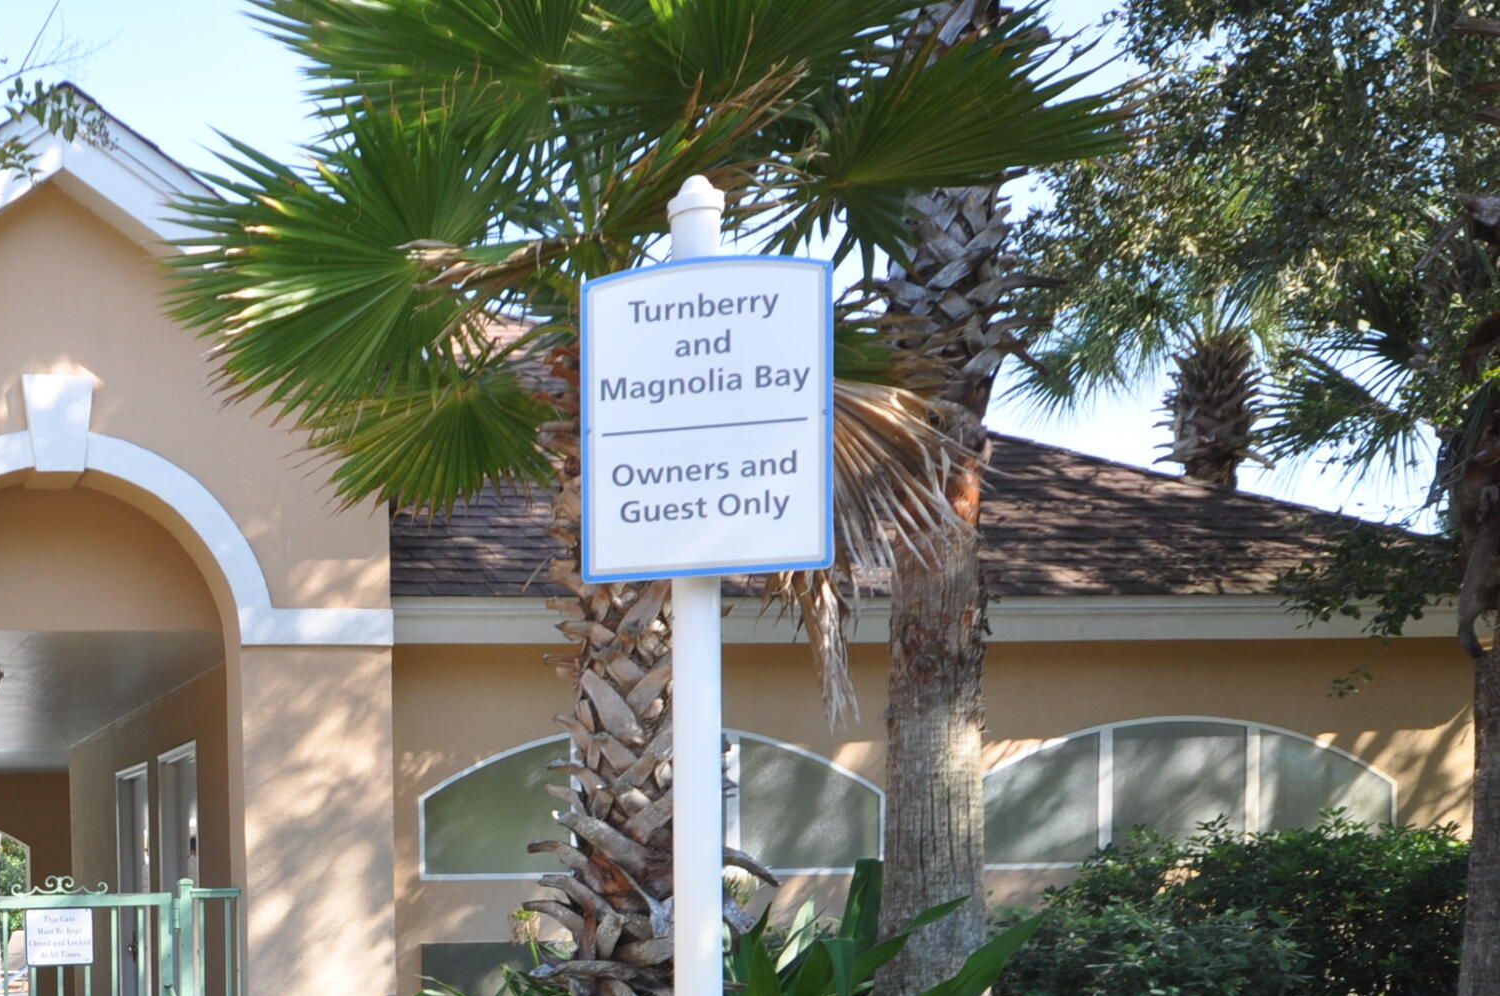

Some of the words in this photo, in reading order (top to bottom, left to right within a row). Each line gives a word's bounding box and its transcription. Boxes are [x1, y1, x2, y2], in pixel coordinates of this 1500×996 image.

[628, 293, 779, 324] Turnberry
[674, 329, 731, 358] and
[600, 367, 743, 404] Magnolia
[755, 365, 811, 393] Bay
[611, 461, 730, 487] Owners
[740, 449, 798, 478] and
[619, 497, 708, 524] Guest
[717, 489, 790, 521] Only
